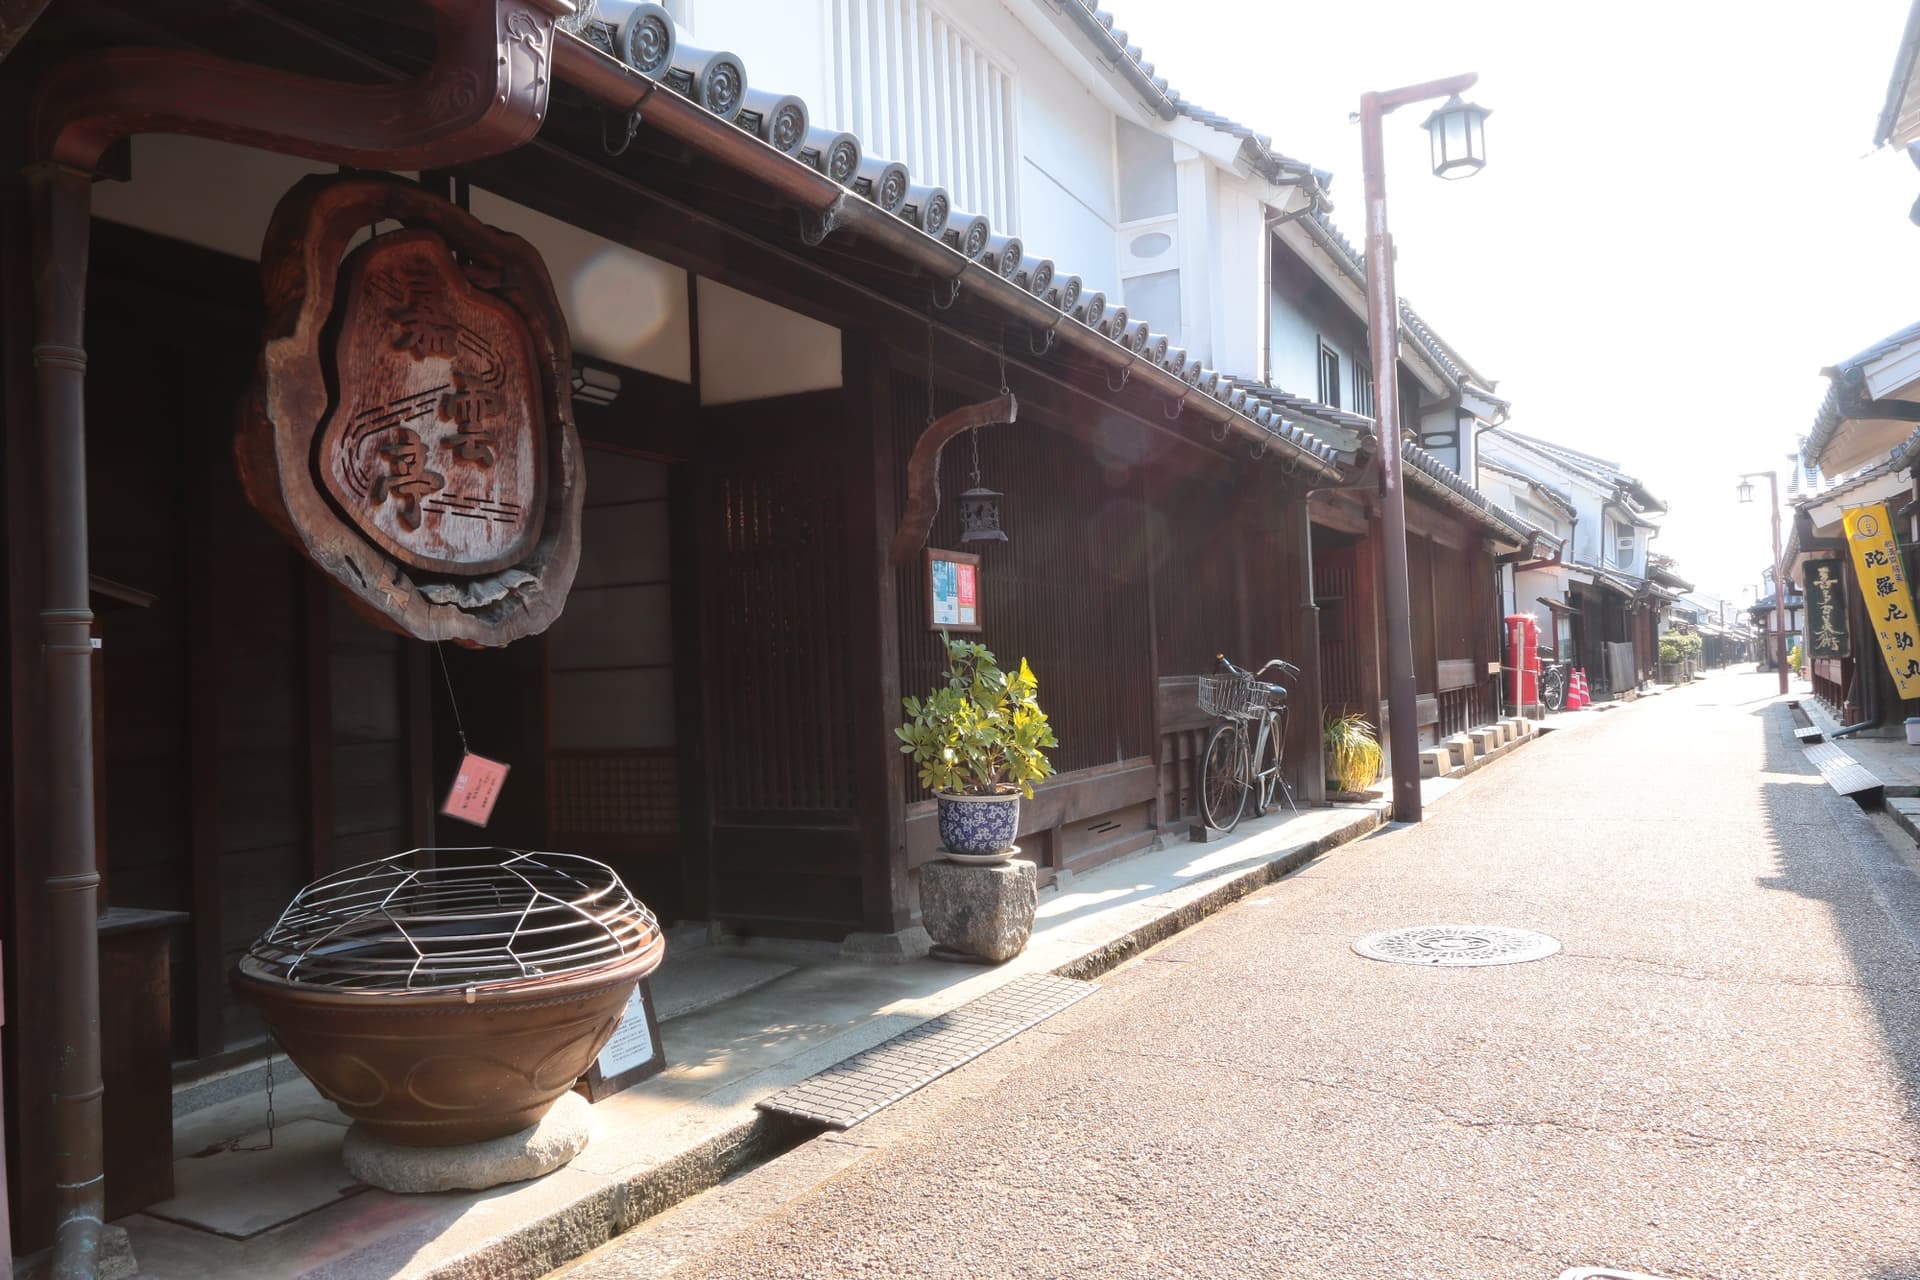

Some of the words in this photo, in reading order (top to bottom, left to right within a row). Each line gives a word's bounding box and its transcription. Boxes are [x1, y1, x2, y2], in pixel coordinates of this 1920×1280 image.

[1865, 550, 1920, 679] 陀羅尼助丸
